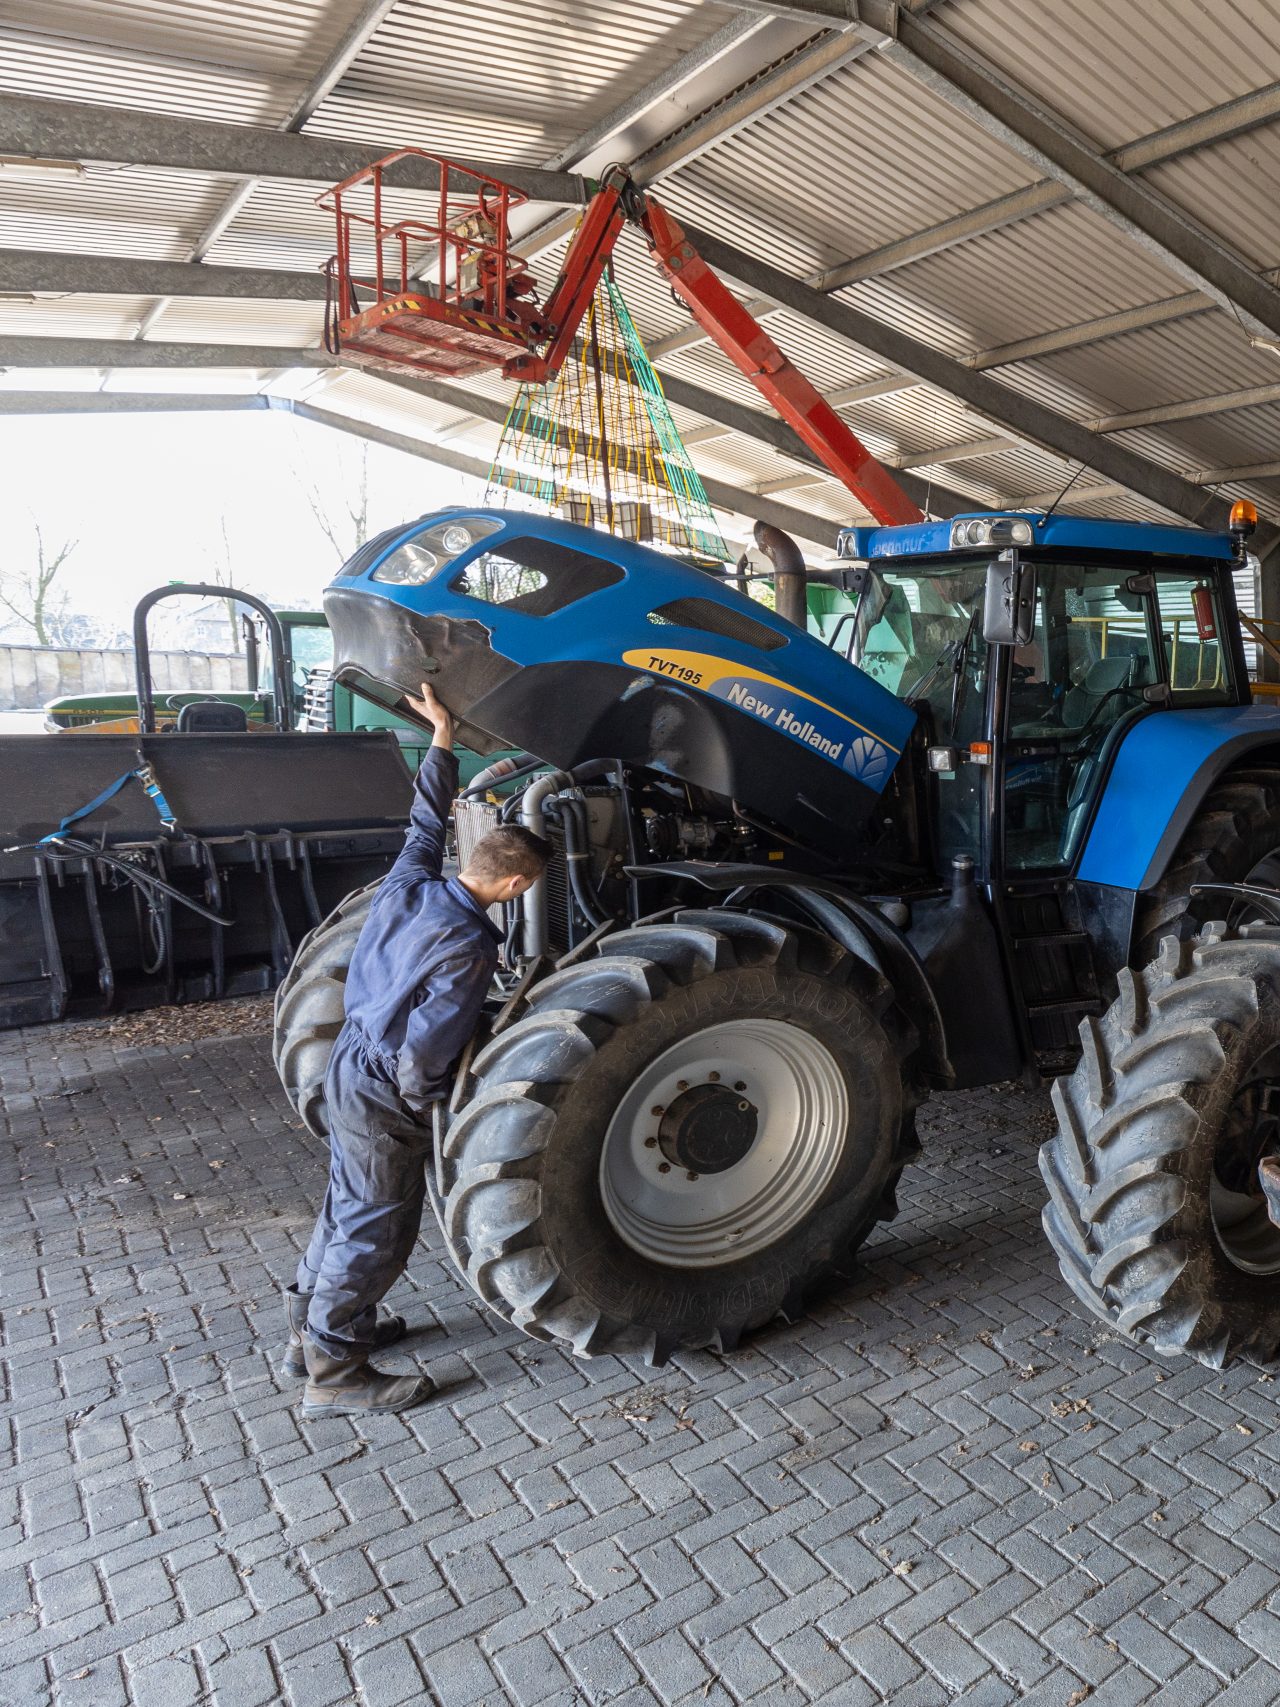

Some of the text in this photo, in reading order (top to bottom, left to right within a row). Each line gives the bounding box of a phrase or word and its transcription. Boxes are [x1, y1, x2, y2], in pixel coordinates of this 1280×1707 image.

[647, 656, 703, 686] TVT195
[727, 682, 844, 760] New Holland
